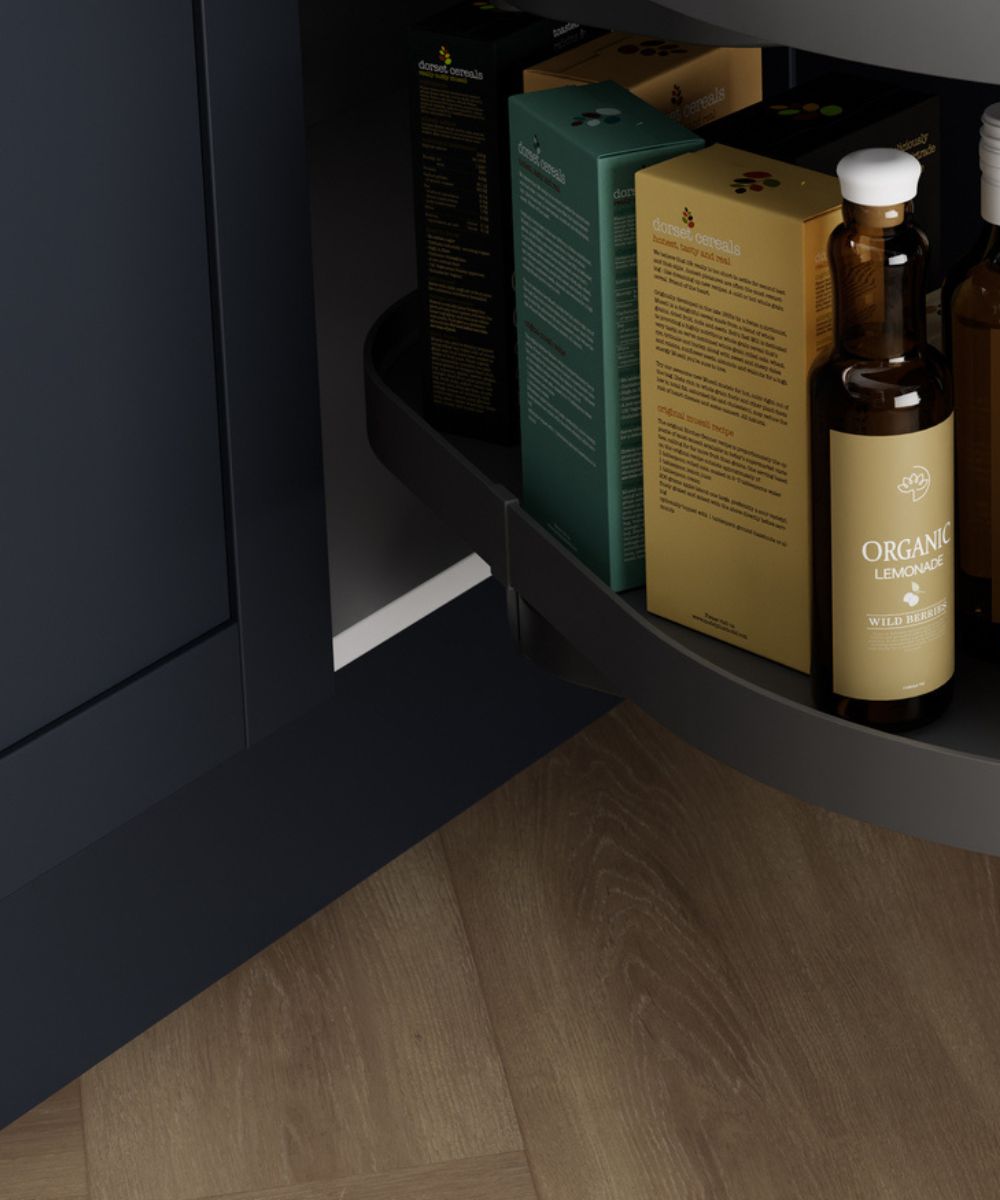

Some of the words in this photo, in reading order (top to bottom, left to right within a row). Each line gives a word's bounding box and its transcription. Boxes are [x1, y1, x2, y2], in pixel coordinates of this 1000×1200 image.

[652, 217, 694, 241] dorset
[695, 232, 742, 256] cereals
[862, 520, 951, 562] ORGANIC
[874, 554, 944, 580] LEMONADE
[869, 617, 903, 627] WILD
[906, 601, 948, 624] BERRIES
